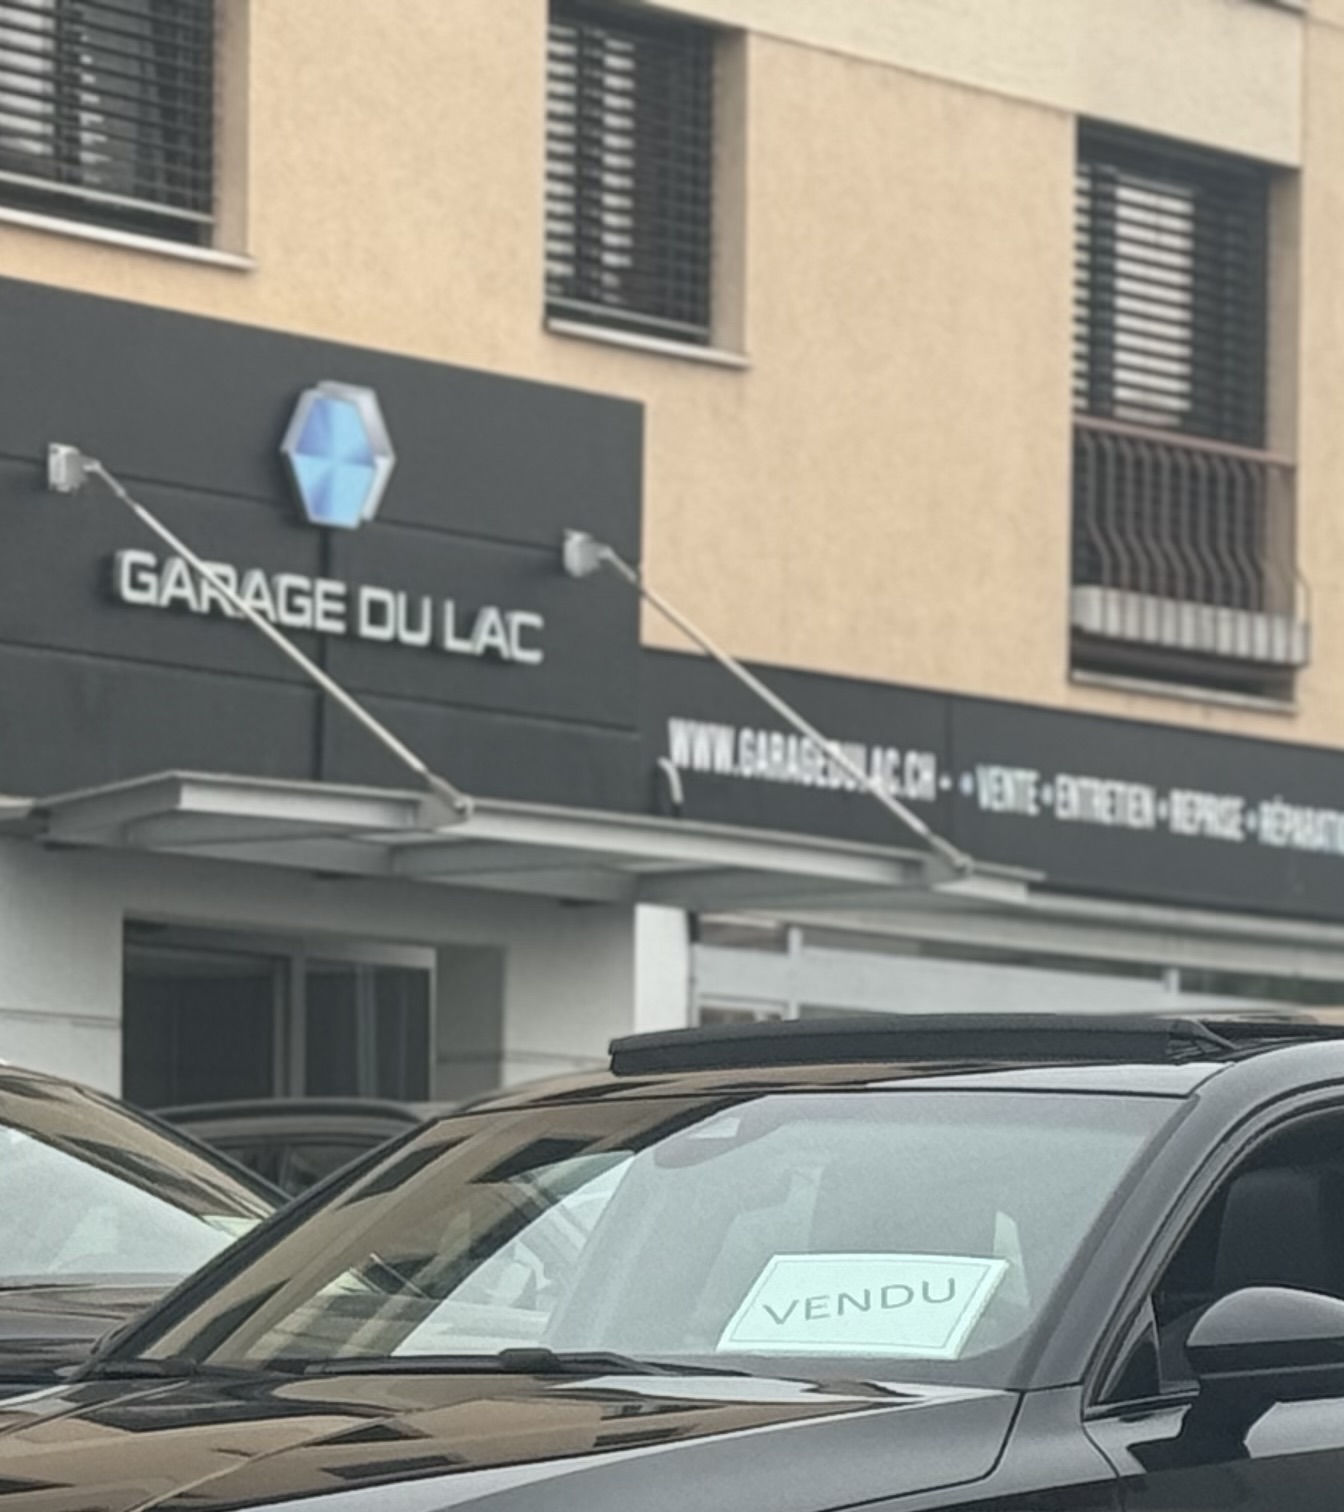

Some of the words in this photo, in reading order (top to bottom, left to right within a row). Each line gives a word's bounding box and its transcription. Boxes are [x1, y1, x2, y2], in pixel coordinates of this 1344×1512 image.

[116, 549, 347, 634] GARAGE
[358, 585, 432, 647] DU
[443, 599, 545, 665] LAC
[975, 763, 1040, 816] VENTE
[762, 1277, 955, 1325] VENDU
